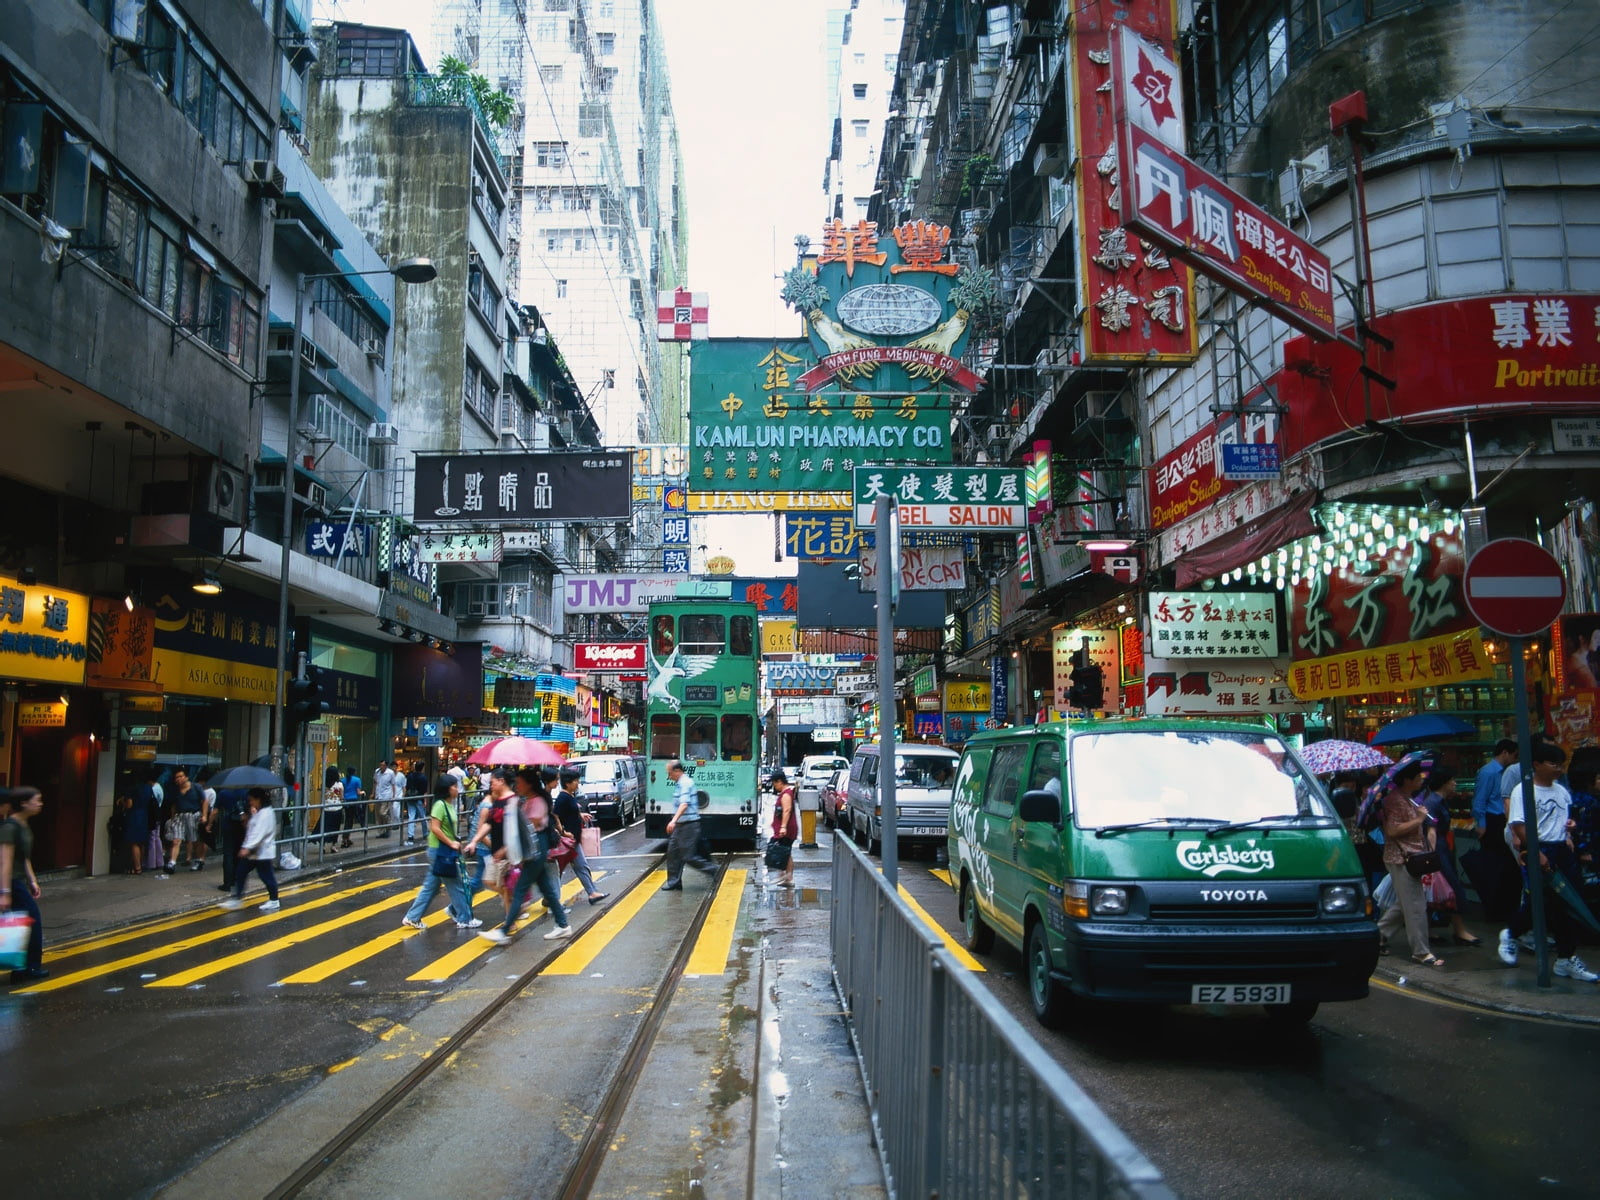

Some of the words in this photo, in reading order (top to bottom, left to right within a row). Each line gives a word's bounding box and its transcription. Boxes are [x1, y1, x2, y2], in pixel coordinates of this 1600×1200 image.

[1298, 290, 1333, 324] Studio
[1490, 299, 1600, 349] 專業
[824, 355, 850, 370] WAH
[852, 350, 881, 363] FUNG
[885, 349, 936, 365] MEDICINE
[1494, 359, 1600, 389] Portrait
[695, 424, 786, 448] KAMLUN
[789, 425, 908, 449] PHARMACY
[912, 425, 944, 448] CO.
[862, 473, 1021, 502] 天使髮型屋
[870, 506, 933, 525] GEL
[949, 506, 1013, 526] SALON
[567, 579, 637, 607] JMJ
[695, 582, 719, 595] 125
[189, 607, 291, 653] 亞洲商業銀
[188, 668, 210, 684] ASIA
[212, 672, 269, 692] COMMERCIAL
[769, 663, 838, 681] TANNOY
[739, 816, 754, 826] 125
[1176, 839, 1276, 878] Carlsberg
[1200, 889, 1268, 902] TOYOTA
[1199, 986, 1227, 1003] EZ
[1233, 985, 1286, 1003] 5931
